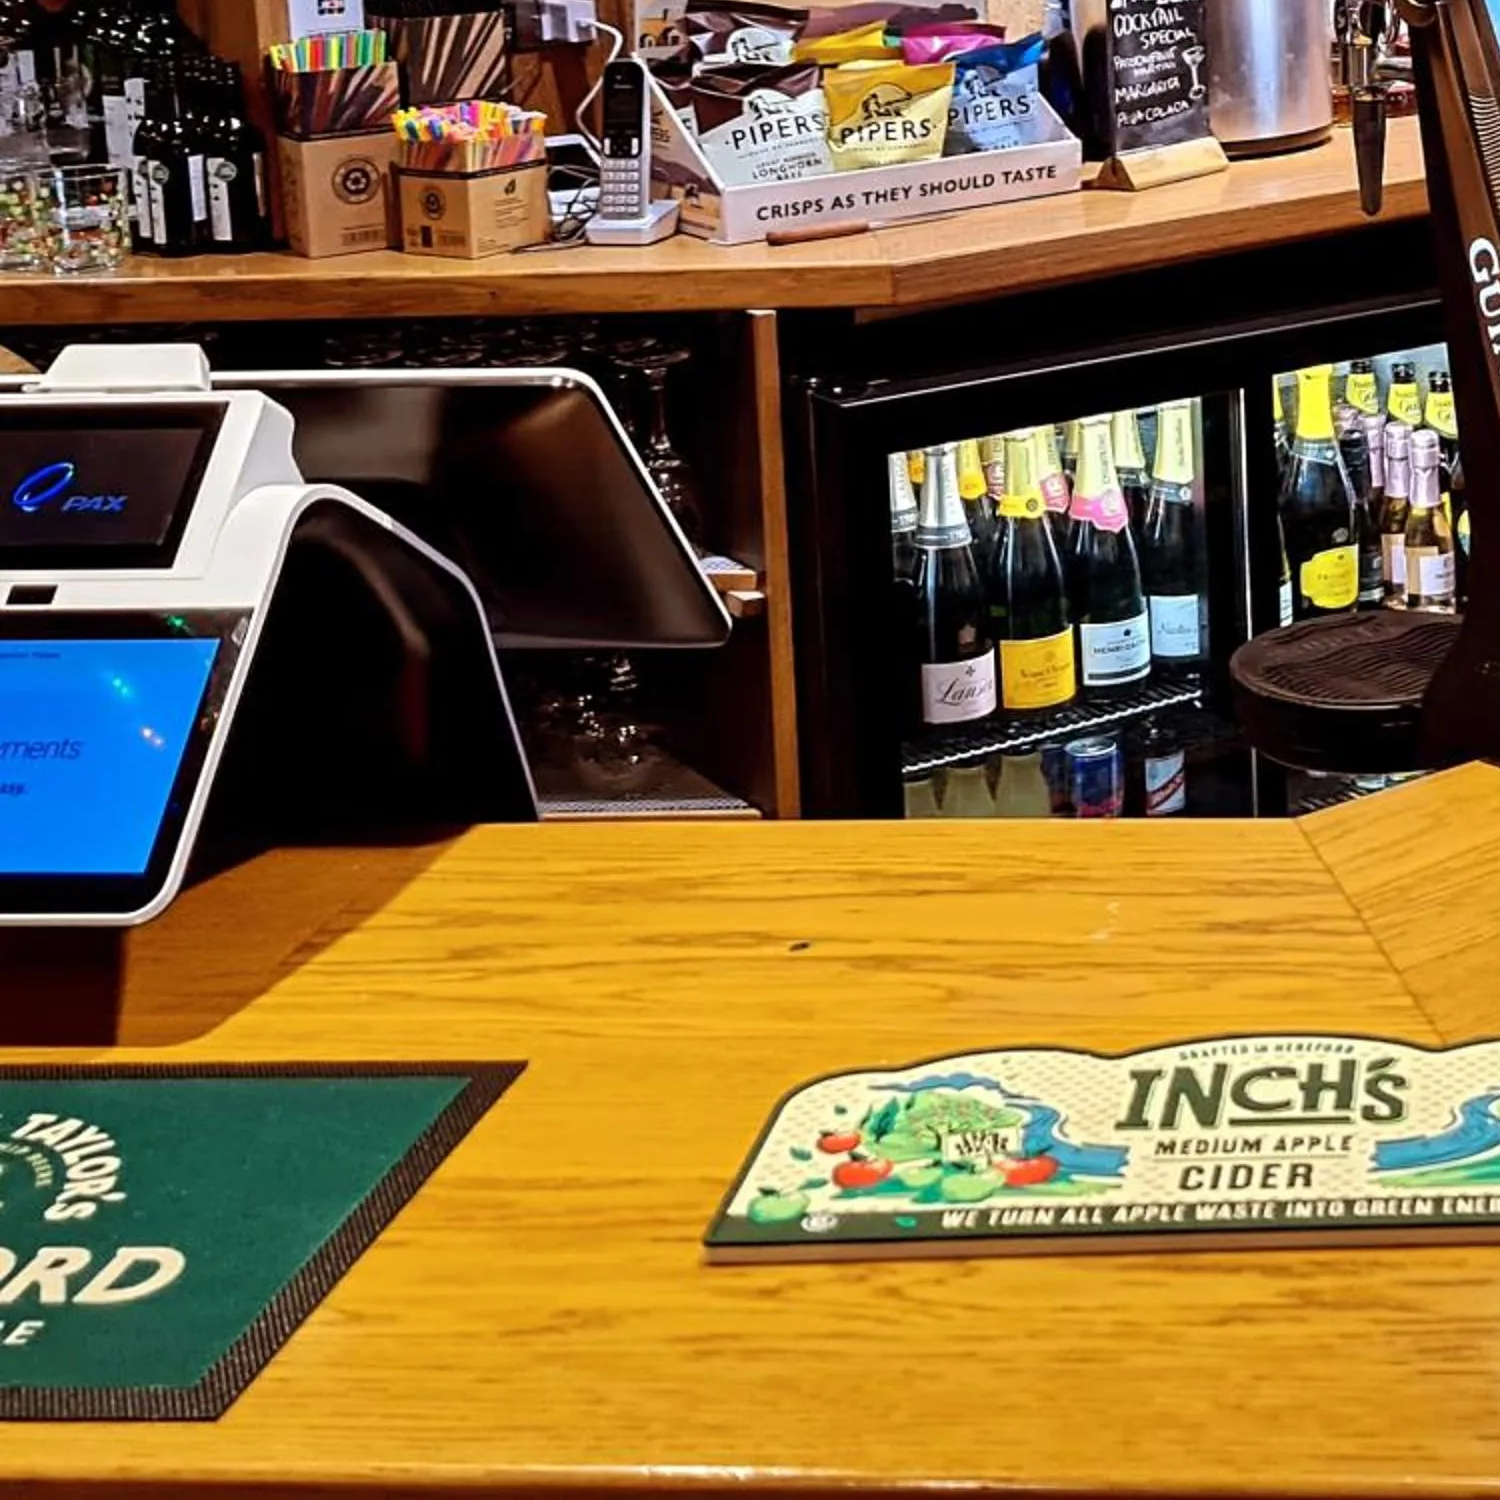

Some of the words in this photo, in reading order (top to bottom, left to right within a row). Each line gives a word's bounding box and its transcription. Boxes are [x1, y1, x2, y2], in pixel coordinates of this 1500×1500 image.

[1113, 6, 1184, 38] COCKTAIL
[1139, 28, 1197, 50] SPECIAL
[948, 94, 1031, 127] PIPERS
[731, 113, 826, 151] PIPERS
[840, 117, 932, 145] PIPERS
[755, 195, 825, 222] CRISPS
[831, 193, 856, 210] AS
[864, 185, 913, 207] THEY
[918, 173, 996, 198] SHOULD
[1000, 164, 1058, 185] TASTE
[61, 495, 128, 512] PAX
[1114, 1057, 1409, 1131] INCH'S
[1154, 1136, 1262, 1156] MEDIUM
[1273, 1135, 1354, 1153] APPLE
[10, 1113, 127, 1221] TAYLOR'S
[1178, 1162, 1315, 1191] CIDER
[941, 1209, 979, 1230] WE
[988, 1207, 1053, 1227] TURN
[1060, 1205, 1103, 1225] ALL
[1112, 1203, 1186, 1224] APPLE
[1196, 1200, 1281, 1221] WASTE
[1285, 1198, 1346, 1219] INTO
[1353, 1197, 1433, 1217] GREEN
